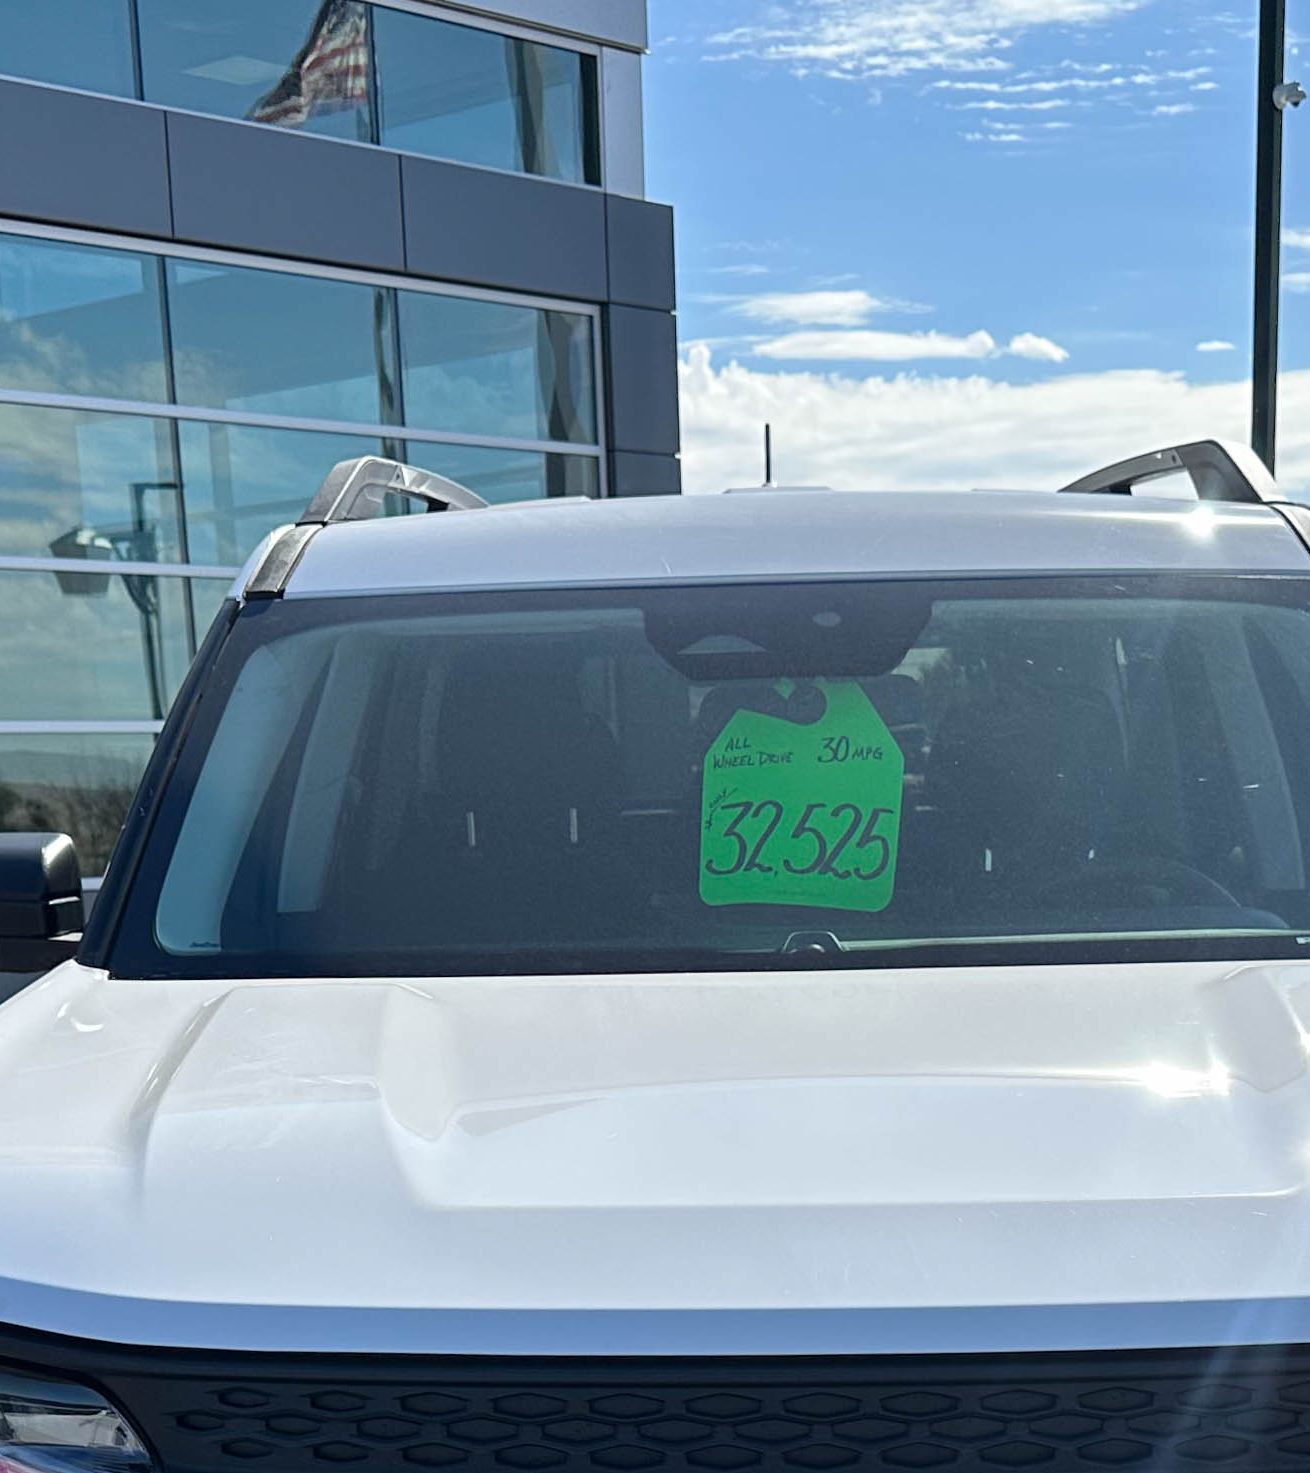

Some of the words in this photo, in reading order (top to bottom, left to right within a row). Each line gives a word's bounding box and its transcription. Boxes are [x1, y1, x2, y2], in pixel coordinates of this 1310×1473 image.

[725, 736, 751, 751] ALL
[817, 736, 850, 763] 30
[852, 747, 883, 760] MPG
[713, 753, 754, 770] WHEEL
[759, 751, 793, 766] DRIVE
